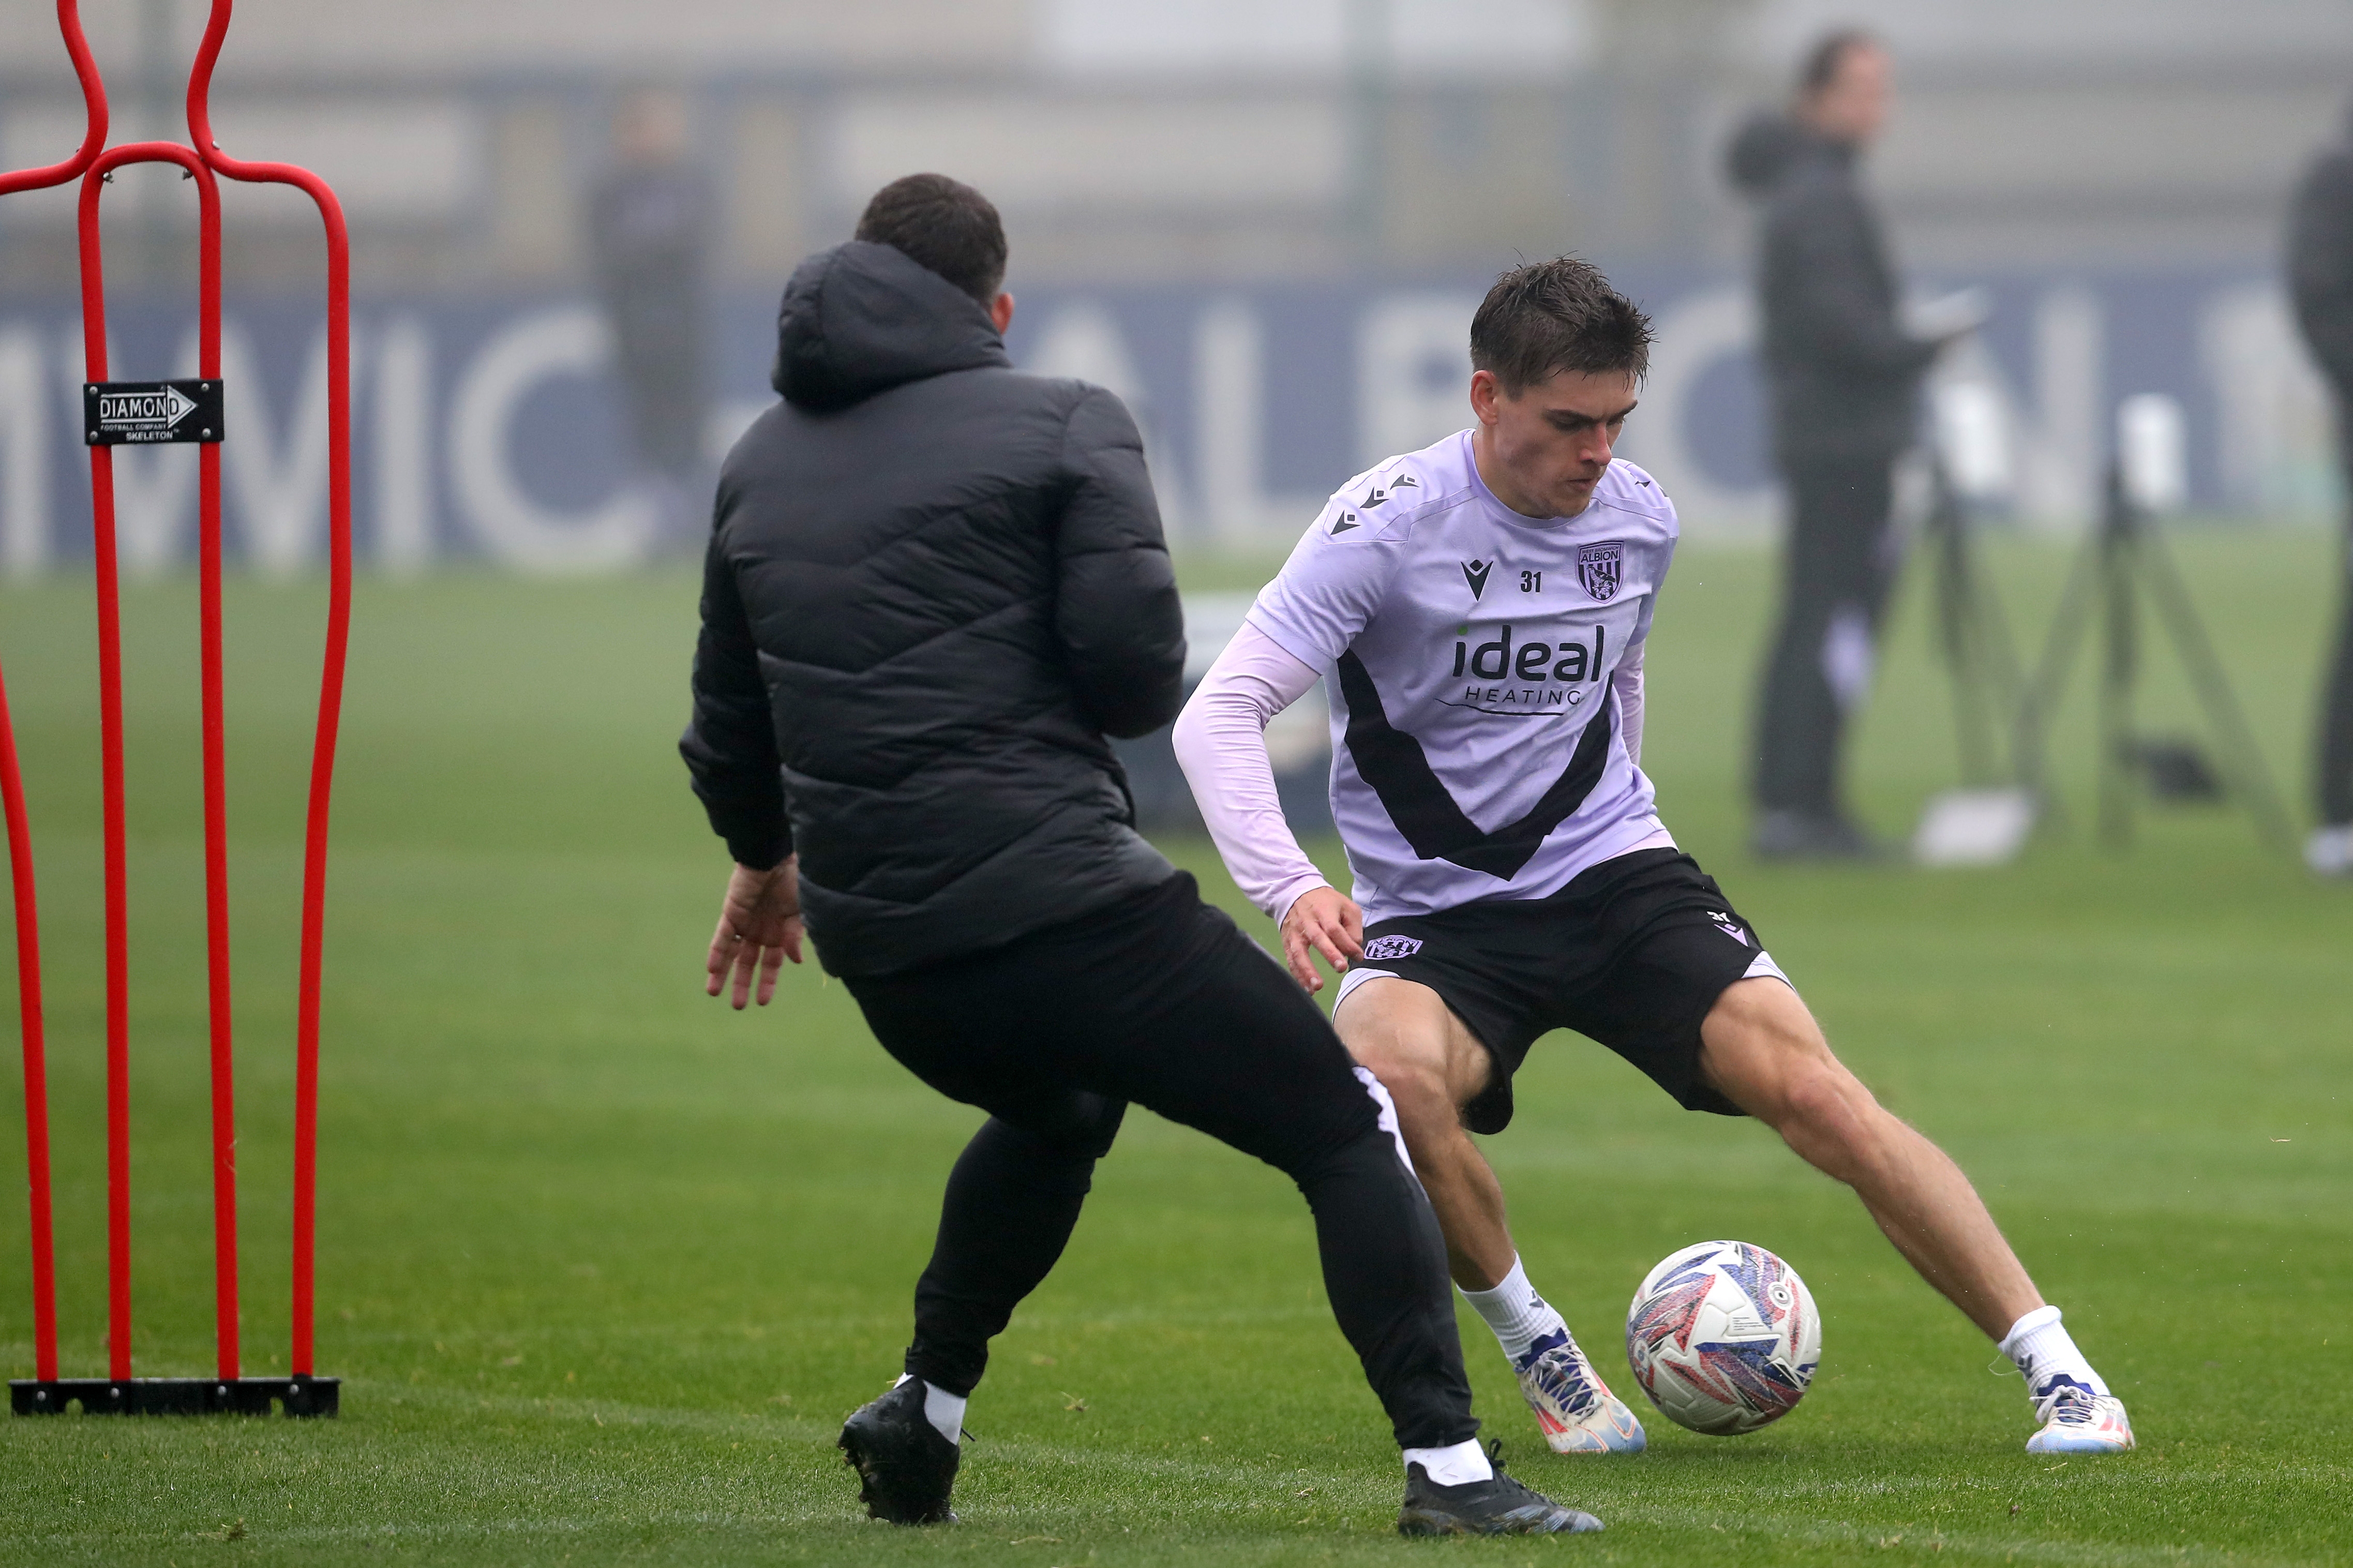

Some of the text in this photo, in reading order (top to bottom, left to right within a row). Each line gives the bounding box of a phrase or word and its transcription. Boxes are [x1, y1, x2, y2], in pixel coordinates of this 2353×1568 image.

[100, 396, 179, 418] DIAMOND
[126, 431, 173, 441] SKELETON
[135, 423, 167, 431] COMPANY
[1581, 550, 1618, 563] ALBION
[1520, 570, 1541, 593] 31
[1452, 624, 1604, 682] ideal
[1465, 686, 1585, 705] HEATING
